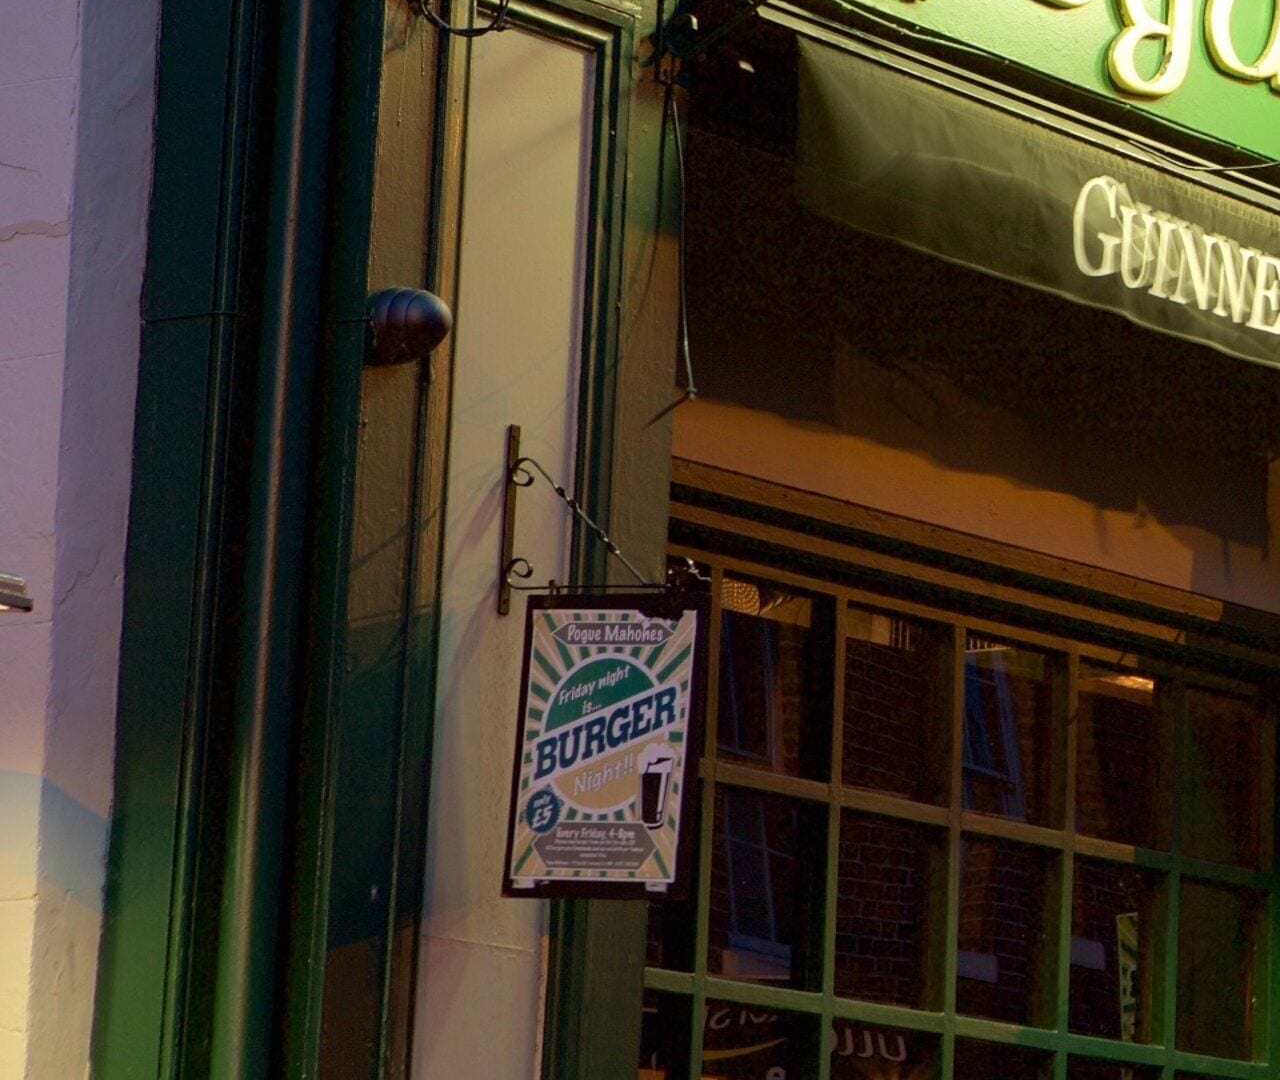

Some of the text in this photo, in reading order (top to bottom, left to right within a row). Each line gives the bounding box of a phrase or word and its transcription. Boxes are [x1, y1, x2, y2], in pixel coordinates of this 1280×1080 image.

[566, 624, 664, 643] Pogue Mahones
[558, 665, 631, 705] Friday night
[533, 685, 678, 780] BURGER
[574, 753, 634, 796] Night!!
[532, 804, 554, 829] £5
[556, 827, 580, 839] Every
